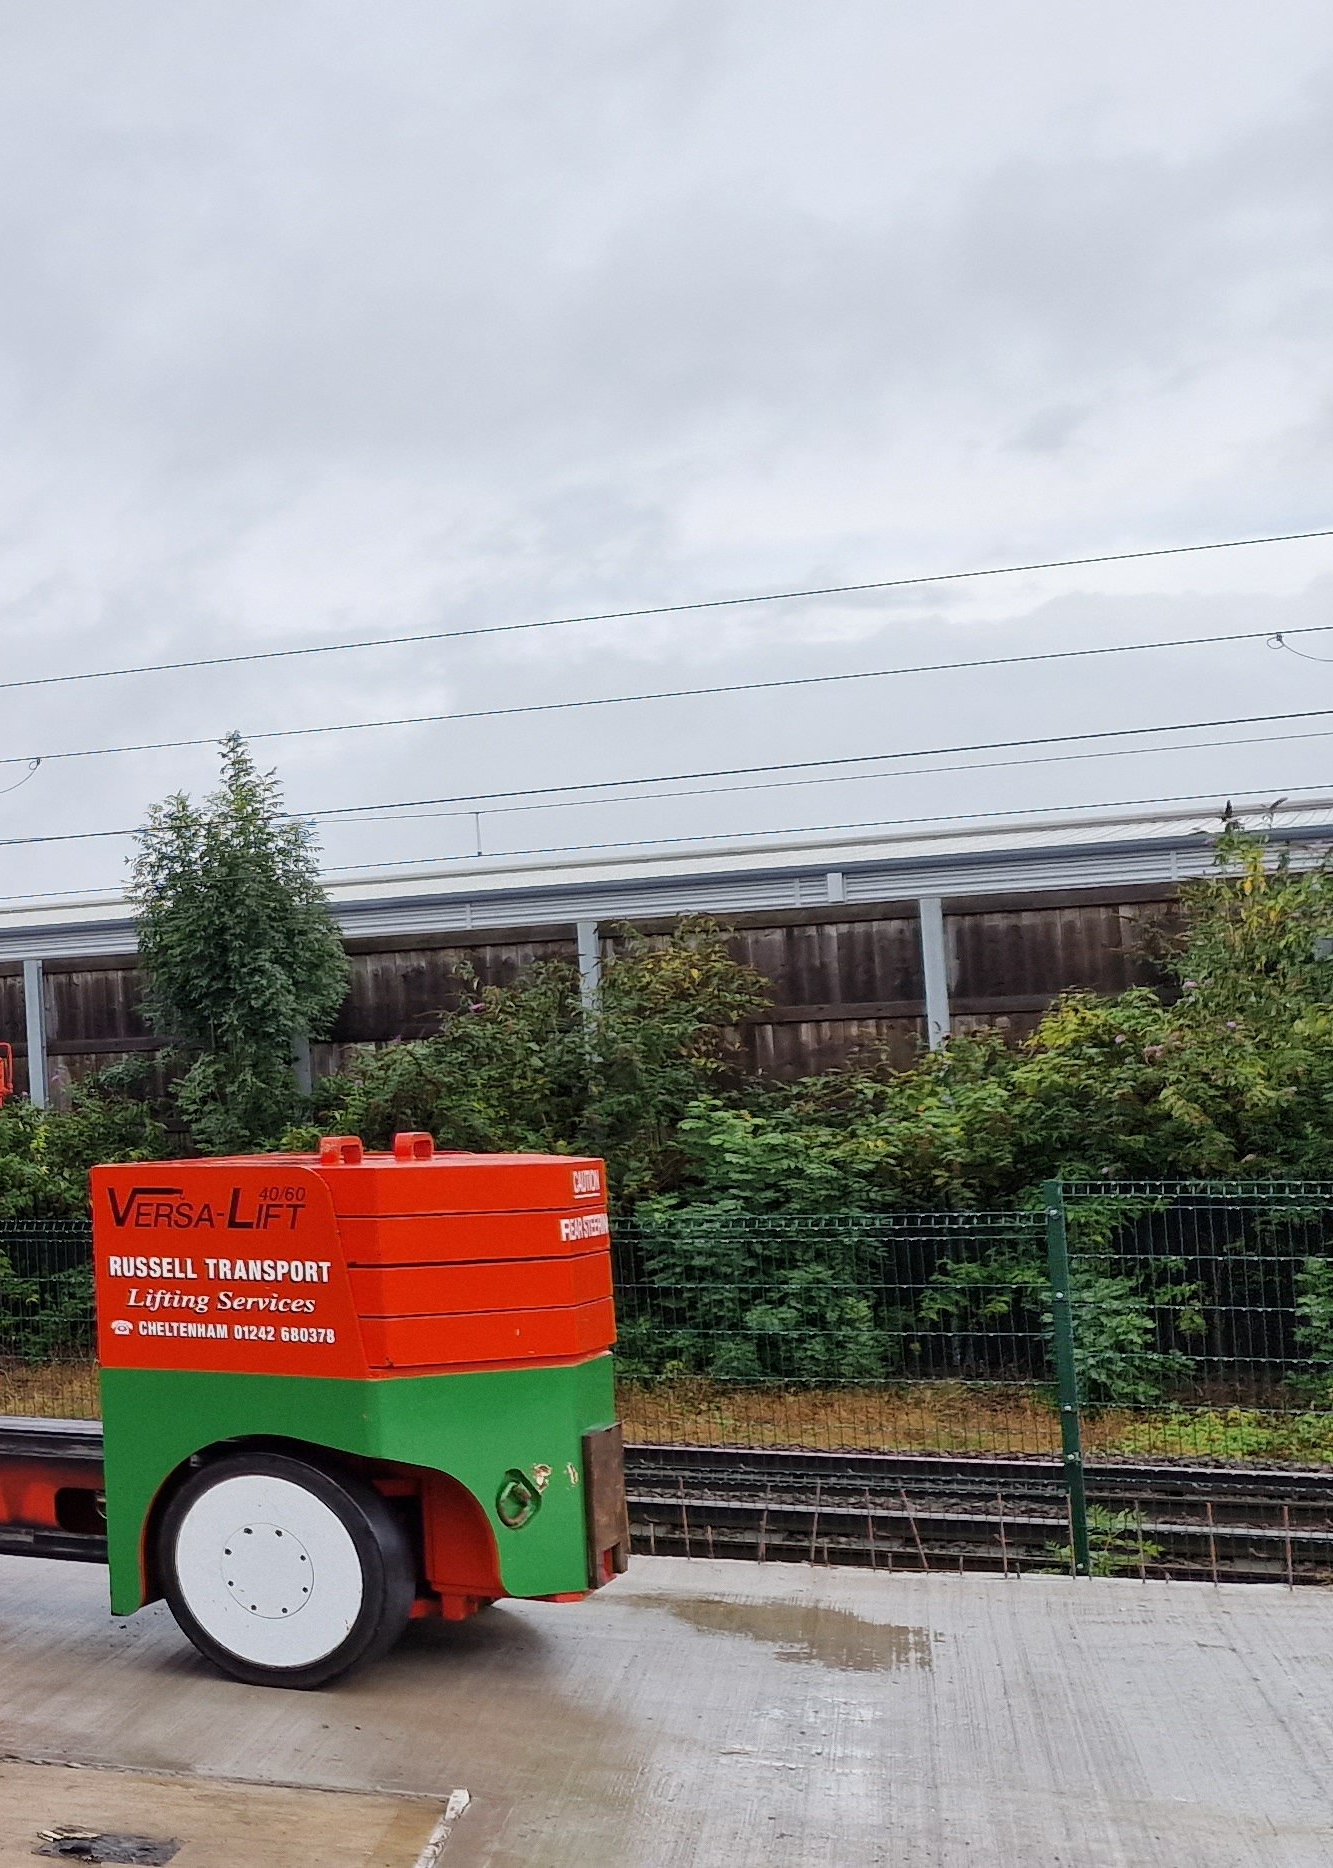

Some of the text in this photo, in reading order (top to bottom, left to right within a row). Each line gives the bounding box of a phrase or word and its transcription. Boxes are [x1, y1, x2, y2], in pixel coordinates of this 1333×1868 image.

[259, 1186, 306, 1200] 40/60
[573, 1169, 601, 1193] CAUTION
[107, 1187, 306, 1230] VERSA-LIFT
[109, 1255, 331, 1283] RUSSELL TRANSPORT
[126, 1288, 316, 1313] Lifting Services
[139, 1321, 335, 1344] CHELTENHAM 01242 680378
